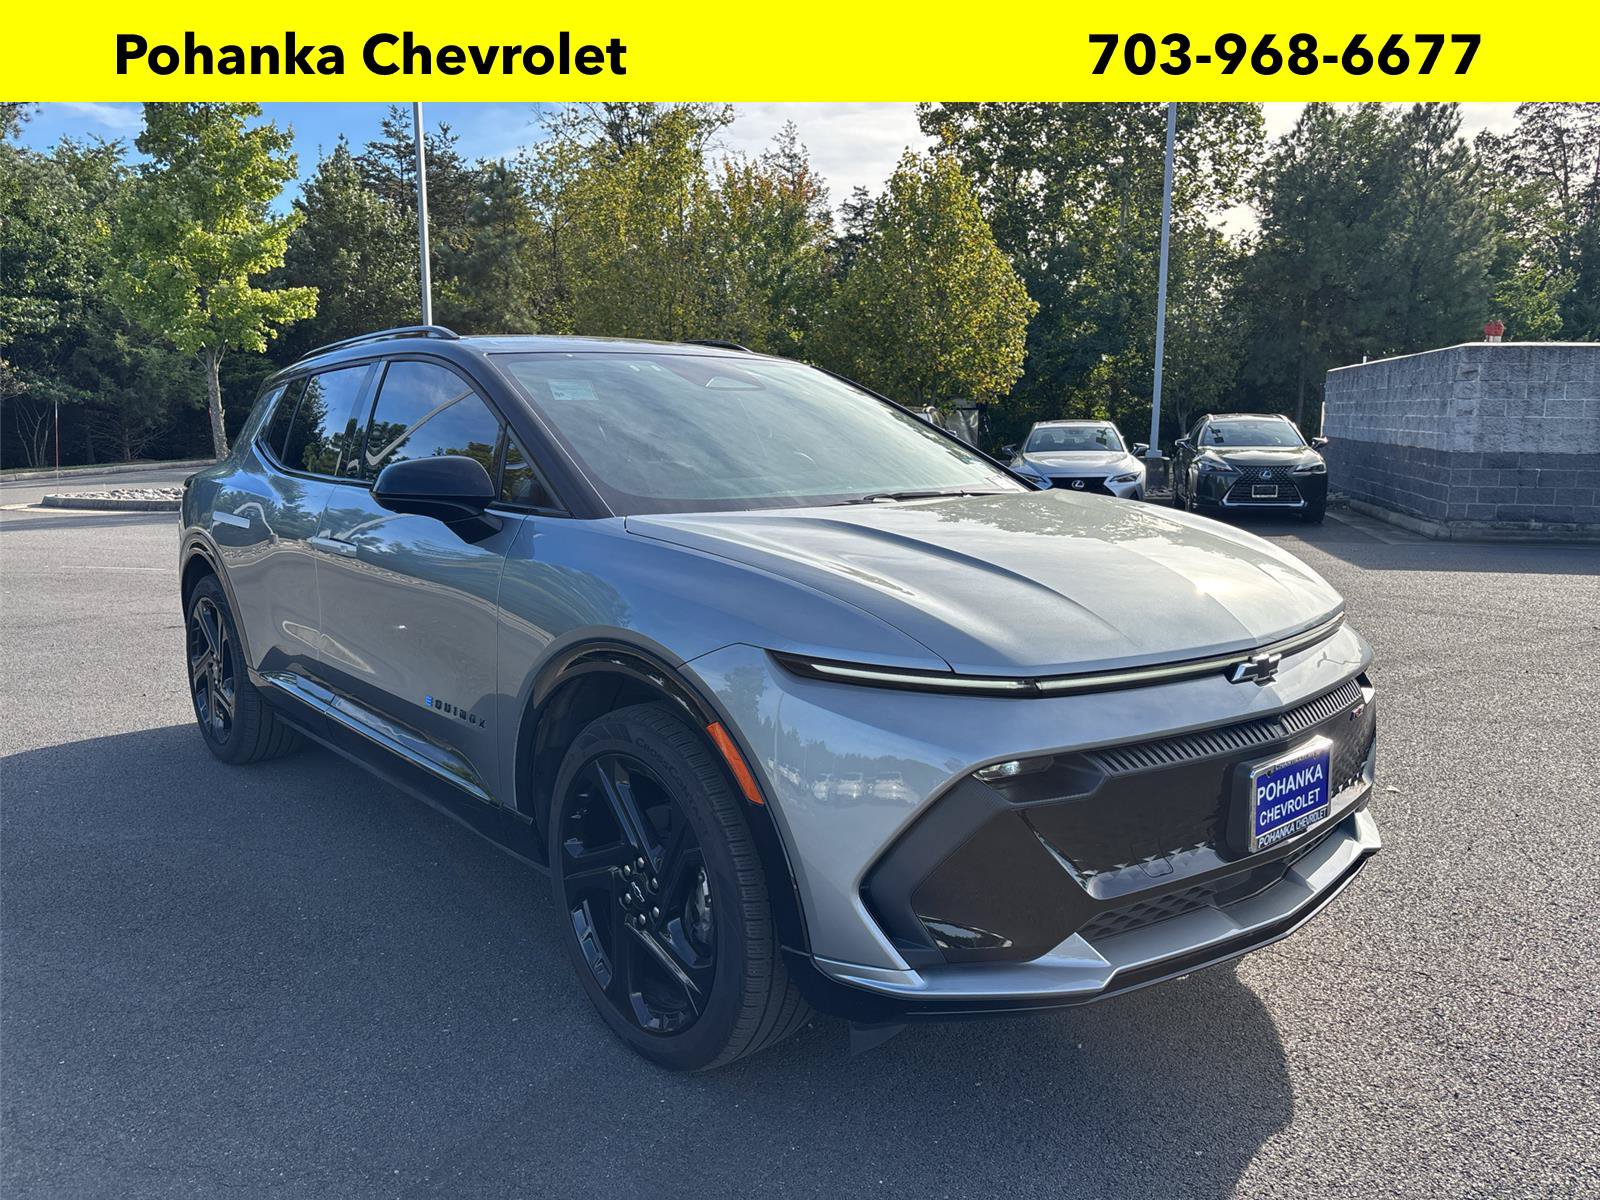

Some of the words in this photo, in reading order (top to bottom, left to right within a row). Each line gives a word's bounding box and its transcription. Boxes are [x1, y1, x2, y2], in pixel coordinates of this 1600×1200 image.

[1257, 763, 1323, 806] POHANKA
[1259, 788, 1321, 827] CHEVROLET
[1258, 822, 1296, 848] POHANKA
[1295, 808, 1328, 832] CHEVROLET
